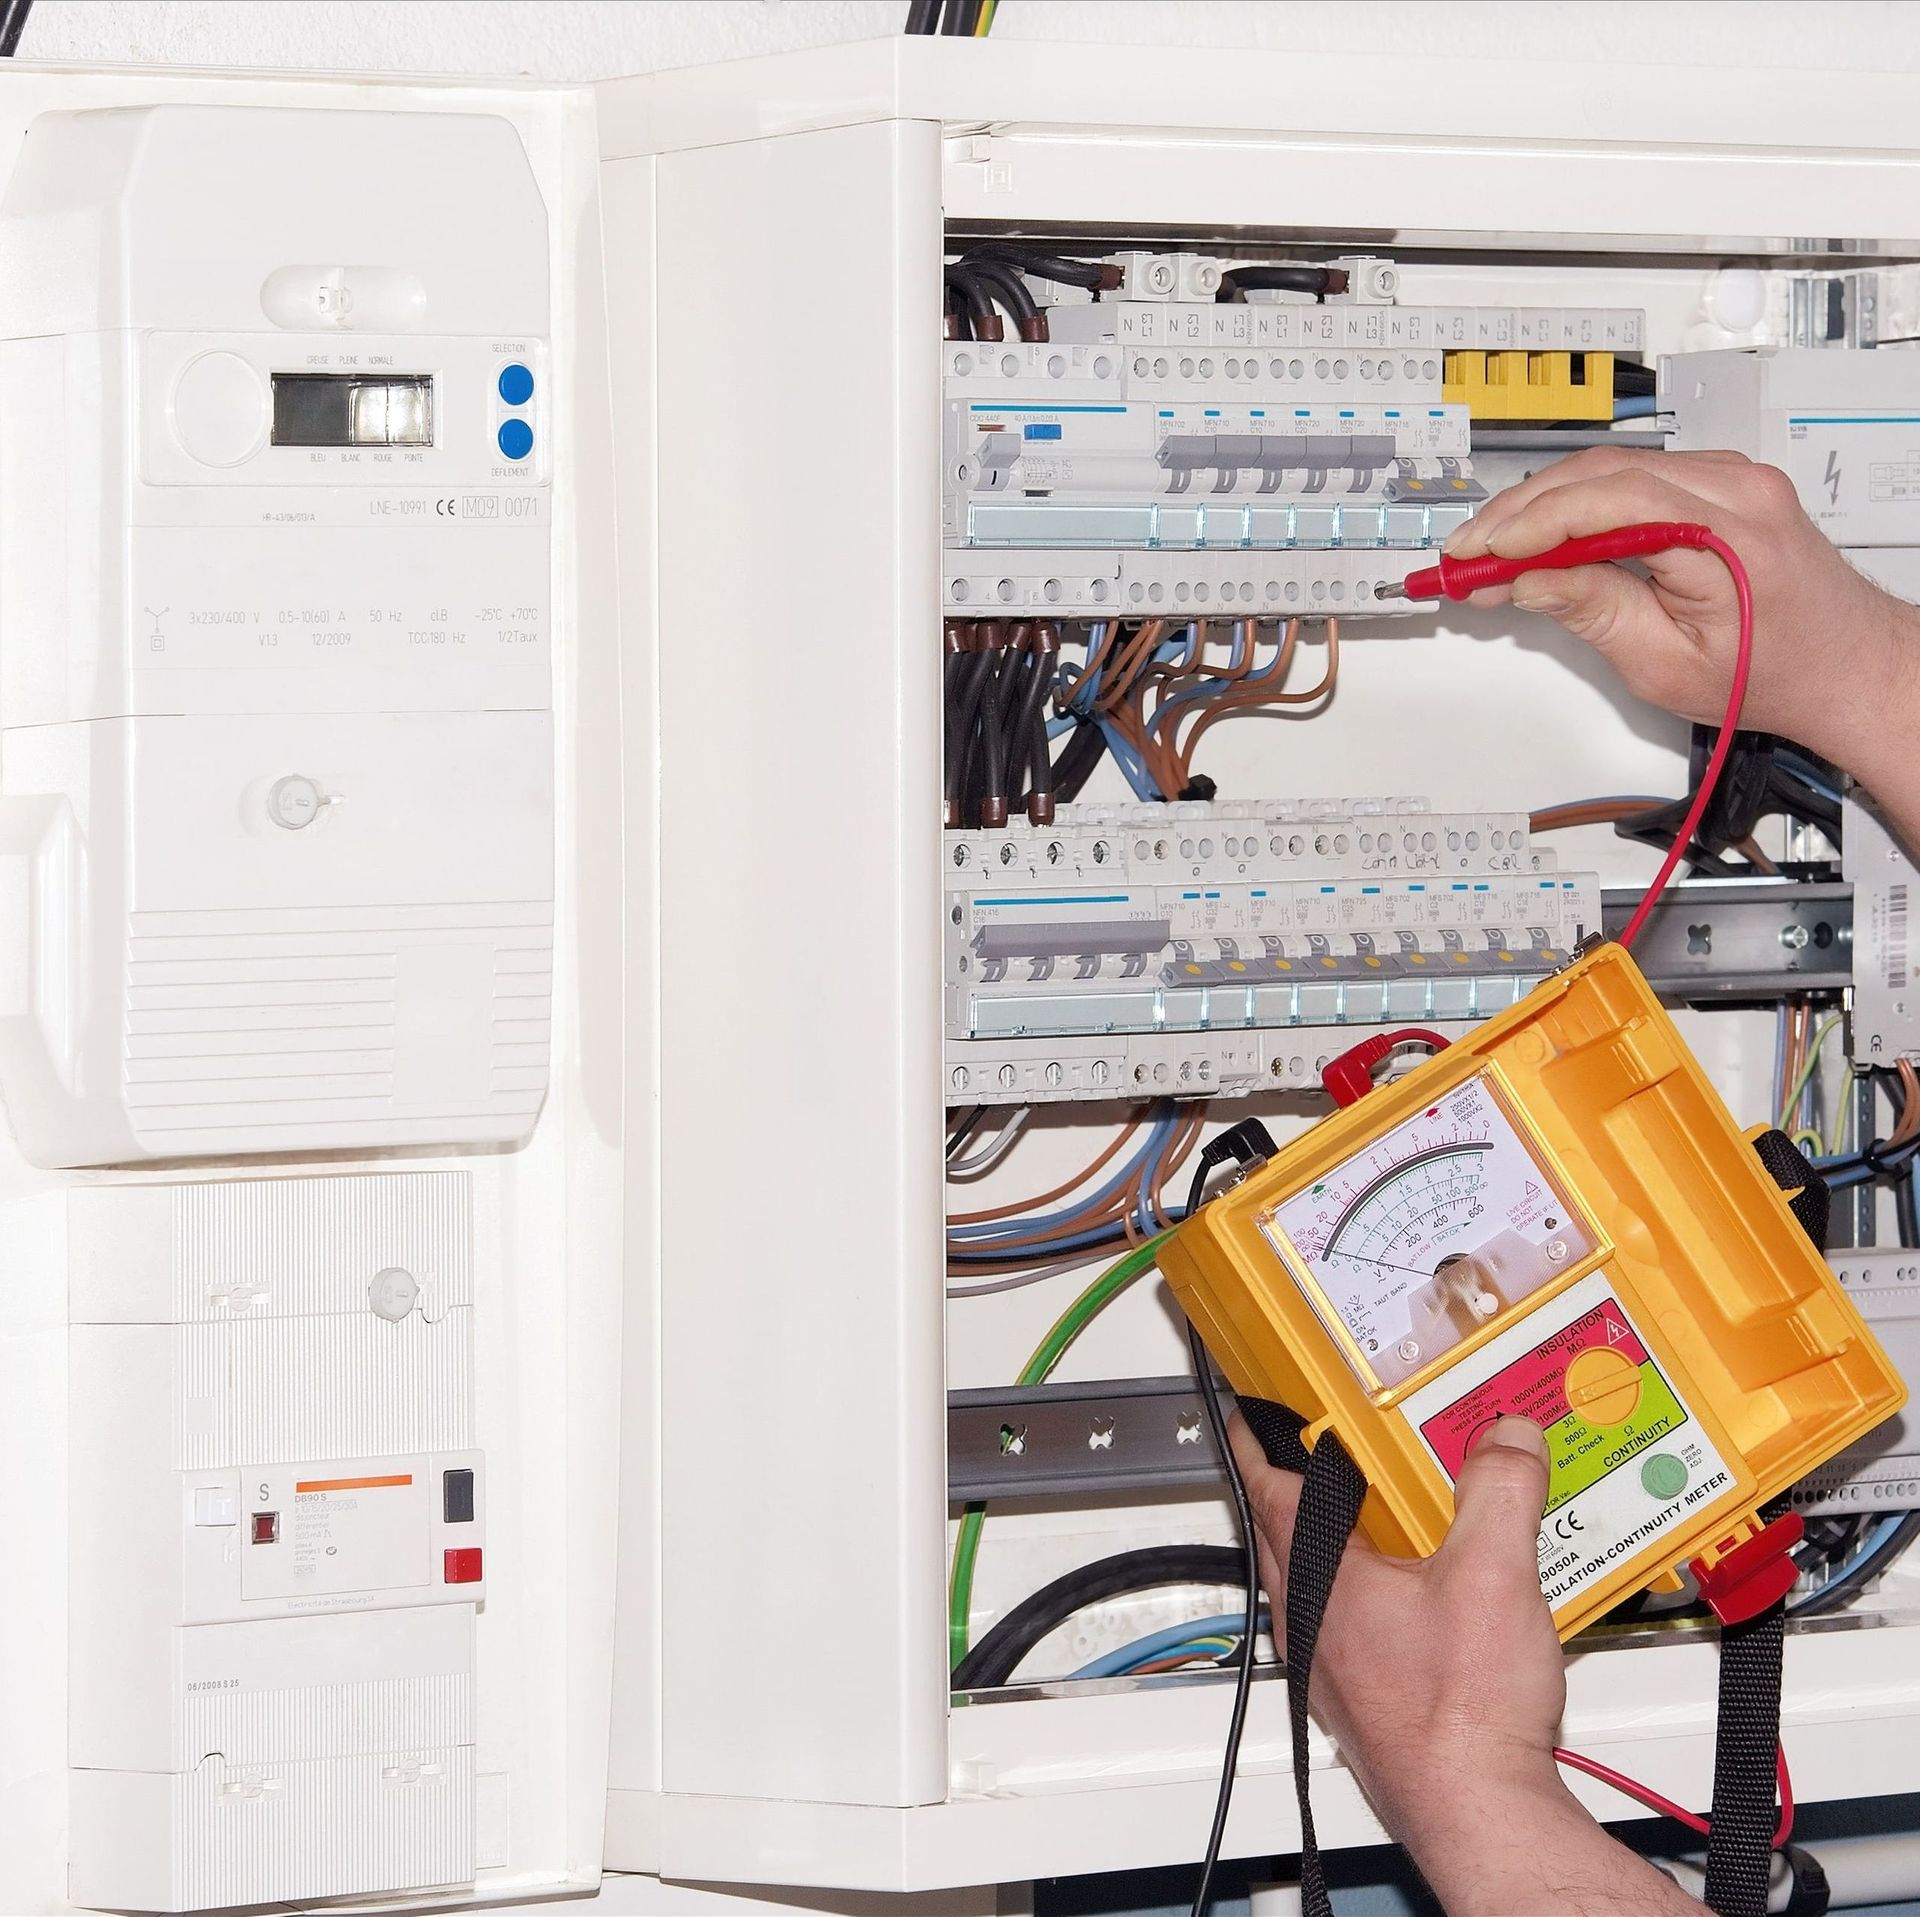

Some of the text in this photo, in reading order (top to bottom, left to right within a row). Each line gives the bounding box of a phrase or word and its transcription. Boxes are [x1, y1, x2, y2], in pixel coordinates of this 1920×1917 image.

[1123, 319, 1133, 332] N
[1141, 326, 1153, 337] L1
[1169, 320, 1178, 332] N
[1215, 320, 1224, 332] N
[1259, 320, 1268, 333] N
[1304, 321, 1312, 333] N
[1349, 321, 1358, 333] N
[1392, 322, 1400, 334] N
[1436, 323, 1444, 335] N
[1480, 324, 1488, 336] N
[1522, 325, 1530, 336] N
[1565, 326, 1573, 337] N
[1188, 327, 1199, 338] L2
[1234, 328, 1245, 338] L3
[1276, 328, 1288, 338] L1
[1321, 328, 1333, 338] L2
[1366, 328, 1378, 339] L3
[1409, 330, 1420, 339] L1
[1608, 326, 1616, 338] N
[492, 344, 526, 353] SELECTION
[368, 356, 394, 366] NORMALE
[310, 454, 326, 462] BLEU
[340, 454, 360, 462] BLANC
[374, 454, 392, 462] ROUGE
[370, 497, 539, 517] LNE-10991 CE M09 0071
[189, 610, 246, 624] 3x230/400
[252, 610, 260, 624] V
[336, 610, 346, 623] A
[369, 610, 382, 622] 50
[389, 609, 403, 622] Hz
[312, 632, 352, 646] 12/2009
[452, 631, 466, 644] Hz
[1482, 1120, 1490, 1128] 0
[1448, 1164, 1462, 1177] 2.5
[1478, 1163, 1484, 1172] 3
[1342, 1181, 1350, 1189] 5
[1426, 1176, 1432, 1184] 2
[1400, 1186, 1413, 1198] 1.5
[1446, 1186, 1462, 1200] 100
[1464, 1184, 1479, 1196] 500
[1330, 1191, 1342, 1202] 10
[1432, 1194, 1443, 1205] 50
[1316, 1210, 1328, 1222] 20
[1406, 1207, 1419, 1218] 20
[1468, 1204, 1484, 1219] 600
[1392, 1221, 1403, 1231] 10
[1433, 1214, 1449, 1230] 400
[1307, 1226, 1320, 1238] 50
[1382, 1234, 1390, 1243] 5
[1405, 1234, 1422, 1248] 200
[1374, 1282, 1408, 1307] TAUT BAND
[1536, 1308, 1605, 1360] INSULATION
[1567, 1338, 1586, 1356] MΩ
[1511, 1366, 1565, 1406] 1000V/400MΩ
[1442, 1410, 1456, 1422] FOR
[1453, 1384, 1494, 1413] CONTINUOUS
[1450, 1419, 1472, 1434] PRESS
[1472, 1409, 1485, 1422] AND
[1484, 1398, 1502, 1412] TURN
[1563, 1416, 1577, 1429] 3Ω
[1565, 1426, 1588, 1446] 500Ω
[1624, 1425, 1634, 1437] Ω
[1603, 1416, 1671, 1468] CONTINUITY
[1557, 1434, 1605, 1469] Batt. Check
[1680, 1443, 1696, 1456] OHM
[1686, 1448, 1702, 1464] ZERO
[259, 1483, 270, 1502] S
[1684, 1472, 1728, 1506] METER
[294, 1492, 328, 1504] DB90 S
[1555, 1510, 1584, 1539] CE
[1540, 1551, 1580, 1584] 9050A
